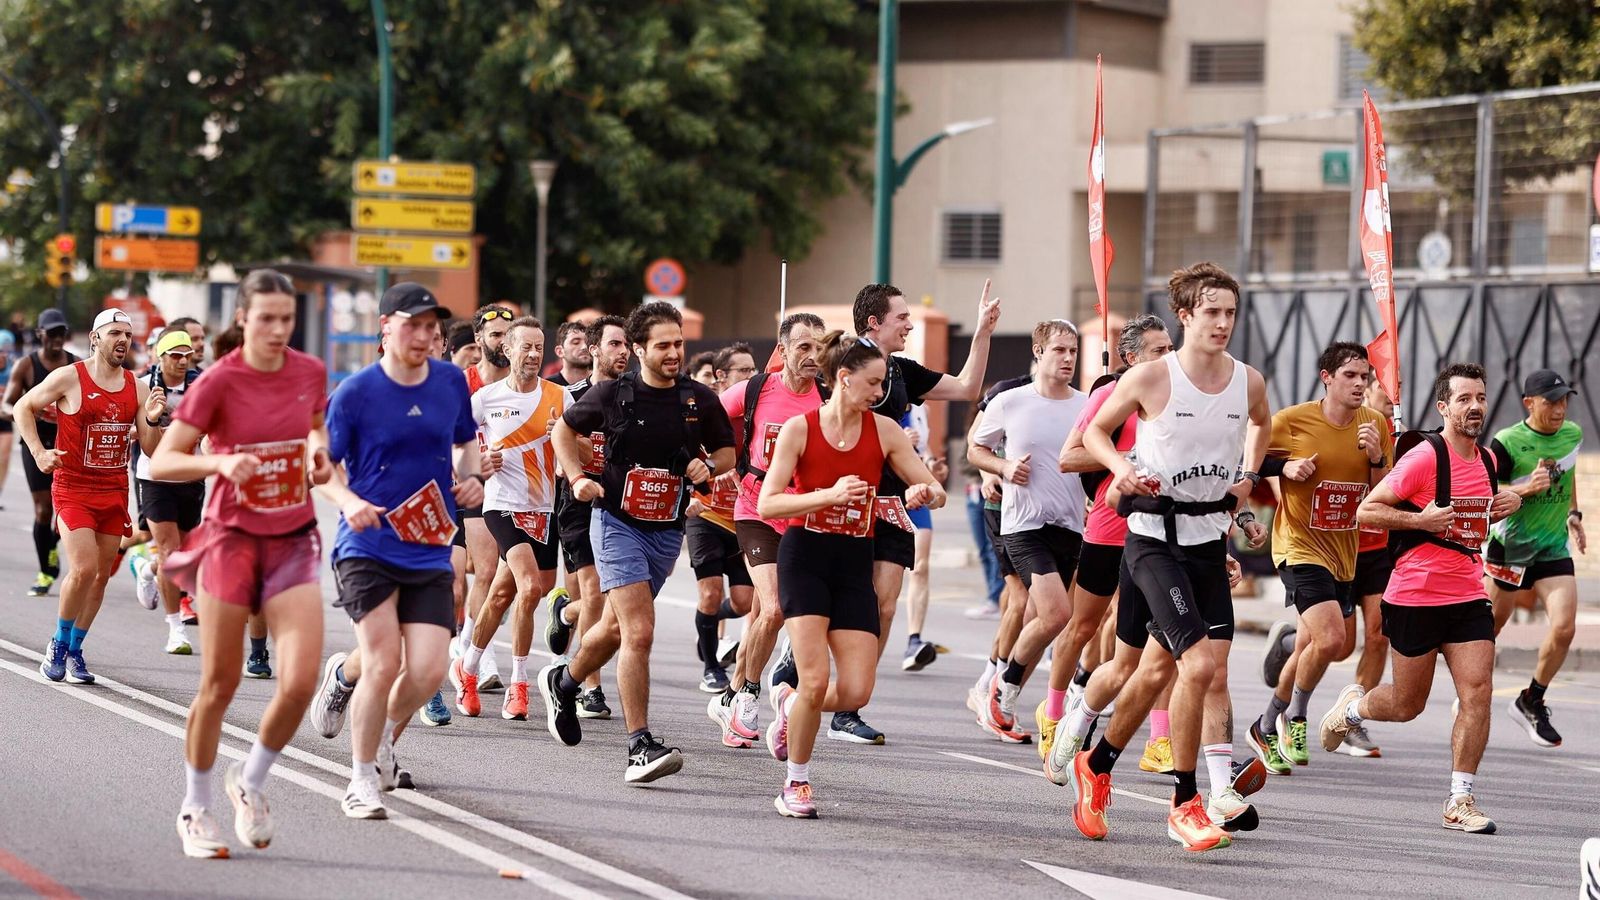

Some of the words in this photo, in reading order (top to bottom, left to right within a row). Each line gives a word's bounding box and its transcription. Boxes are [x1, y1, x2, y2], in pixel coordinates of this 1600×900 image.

[101, 435, 118, 444] 537
[644, 470, 679, 480] GENERALI
[640, 481, 668, 493] 3665
[1328, 494, 1347, 503] 836
